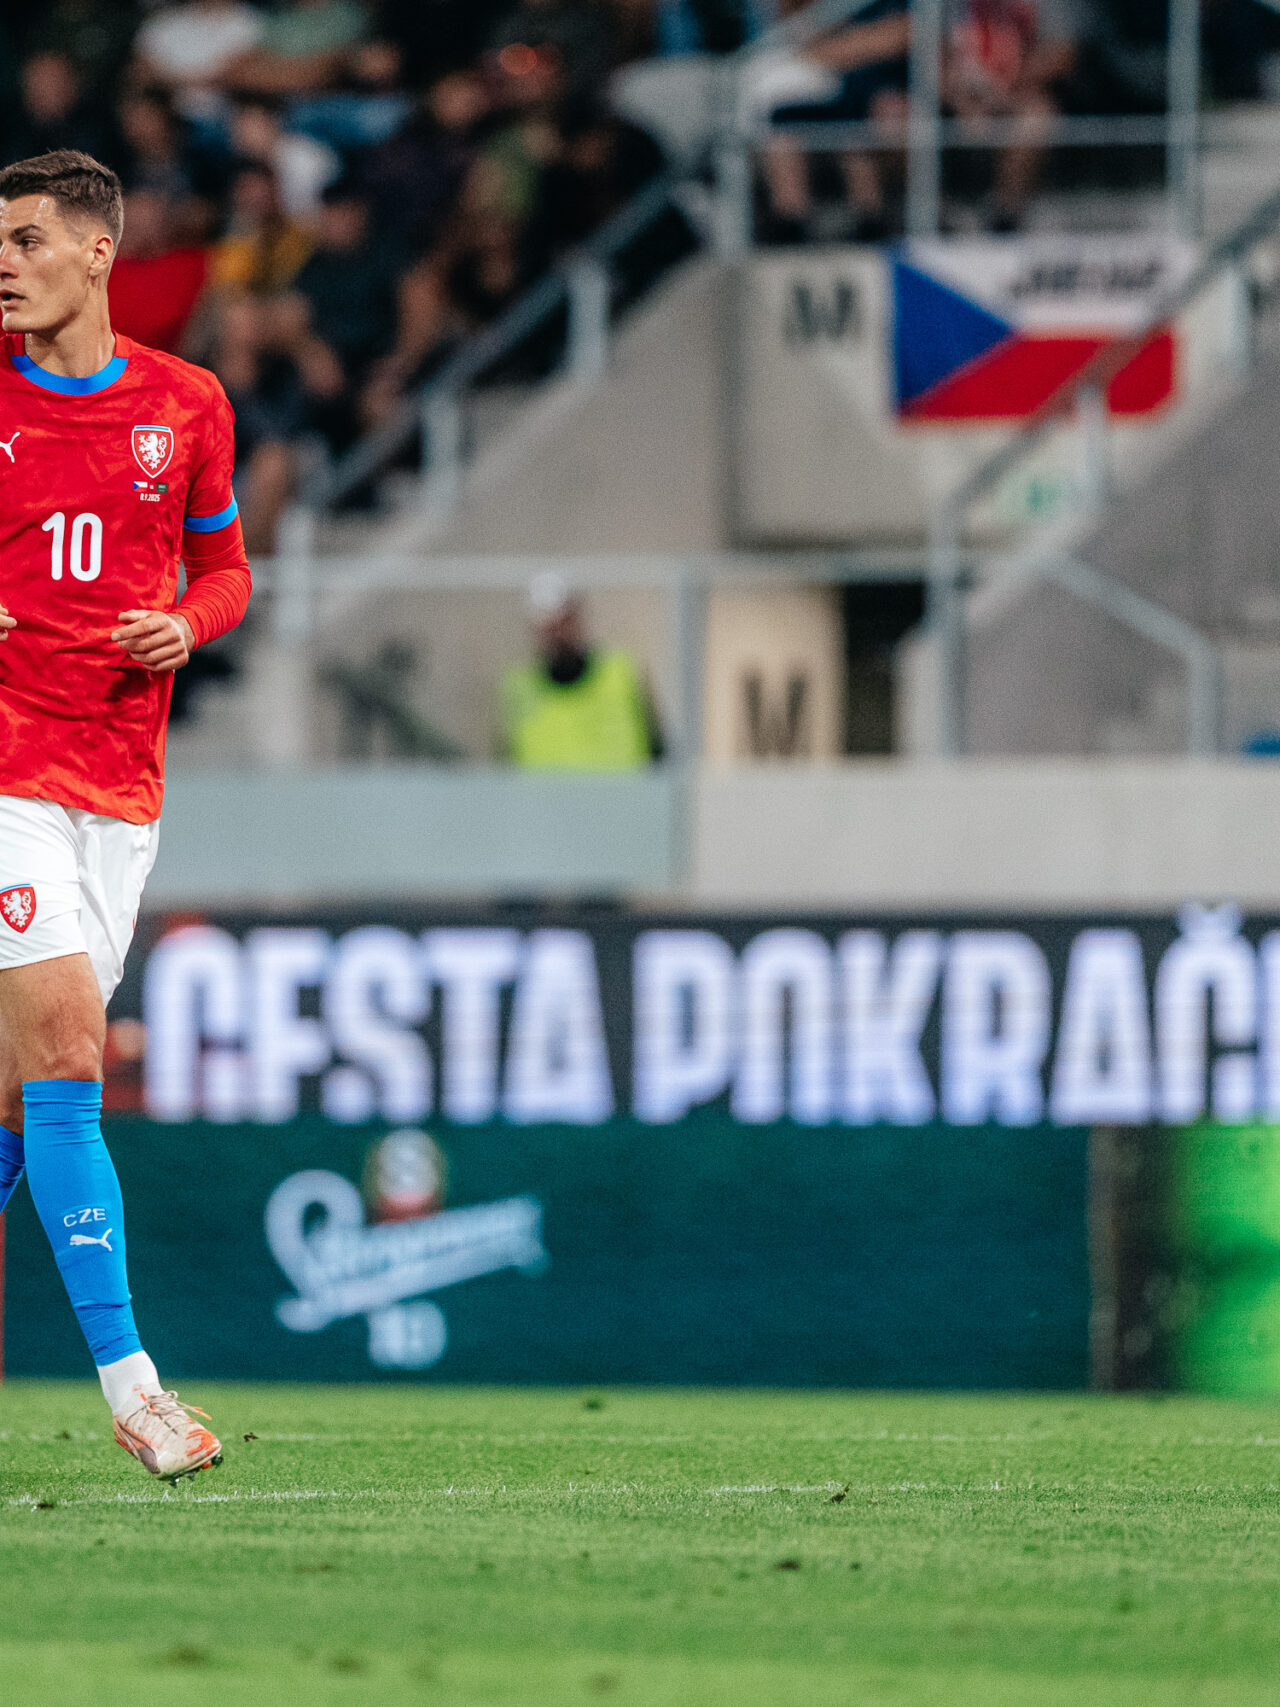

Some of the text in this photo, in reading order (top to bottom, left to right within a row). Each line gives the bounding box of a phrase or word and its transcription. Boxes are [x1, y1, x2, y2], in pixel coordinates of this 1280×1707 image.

[41, 511, 103, 582] 10
[631, 898, 1280, 1126] POKRAČ
[63, 1208, 107, 1228] CZE
